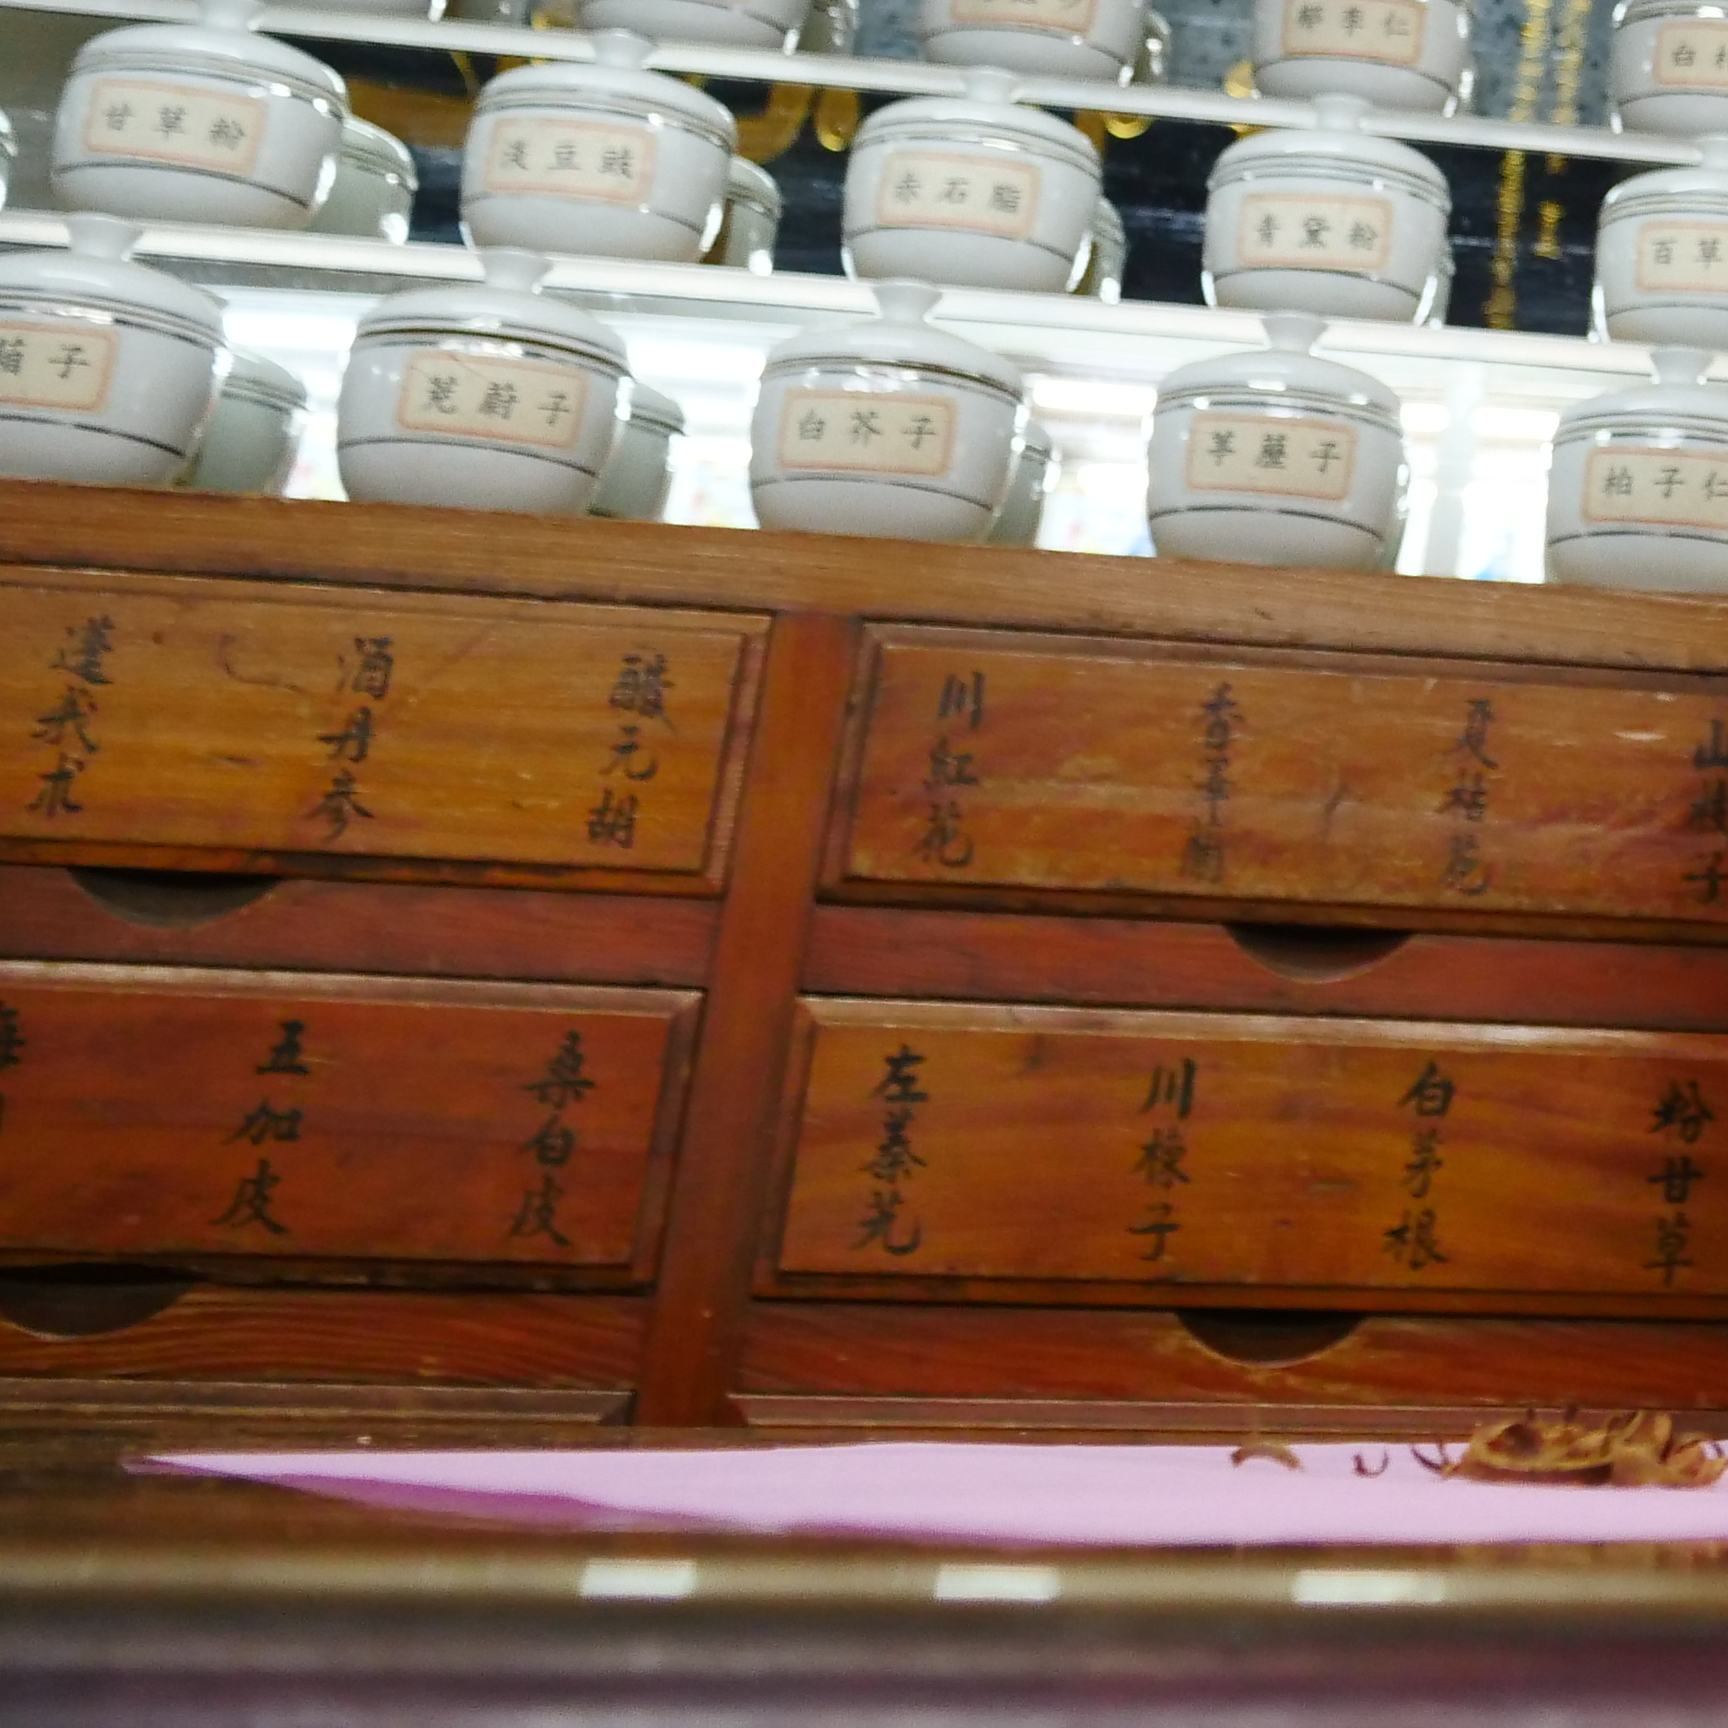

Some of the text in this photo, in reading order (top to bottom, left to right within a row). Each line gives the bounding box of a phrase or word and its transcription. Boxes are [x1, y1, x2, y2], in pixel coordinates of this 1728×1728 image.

[105, 103, 245, 149] 甘草粉
[209, 1019, 312, 1237] 五加皮
[507, 1032, 597, 1247] 桑白皮
[1644, 1081, 1715, 1286] 粉甘草
